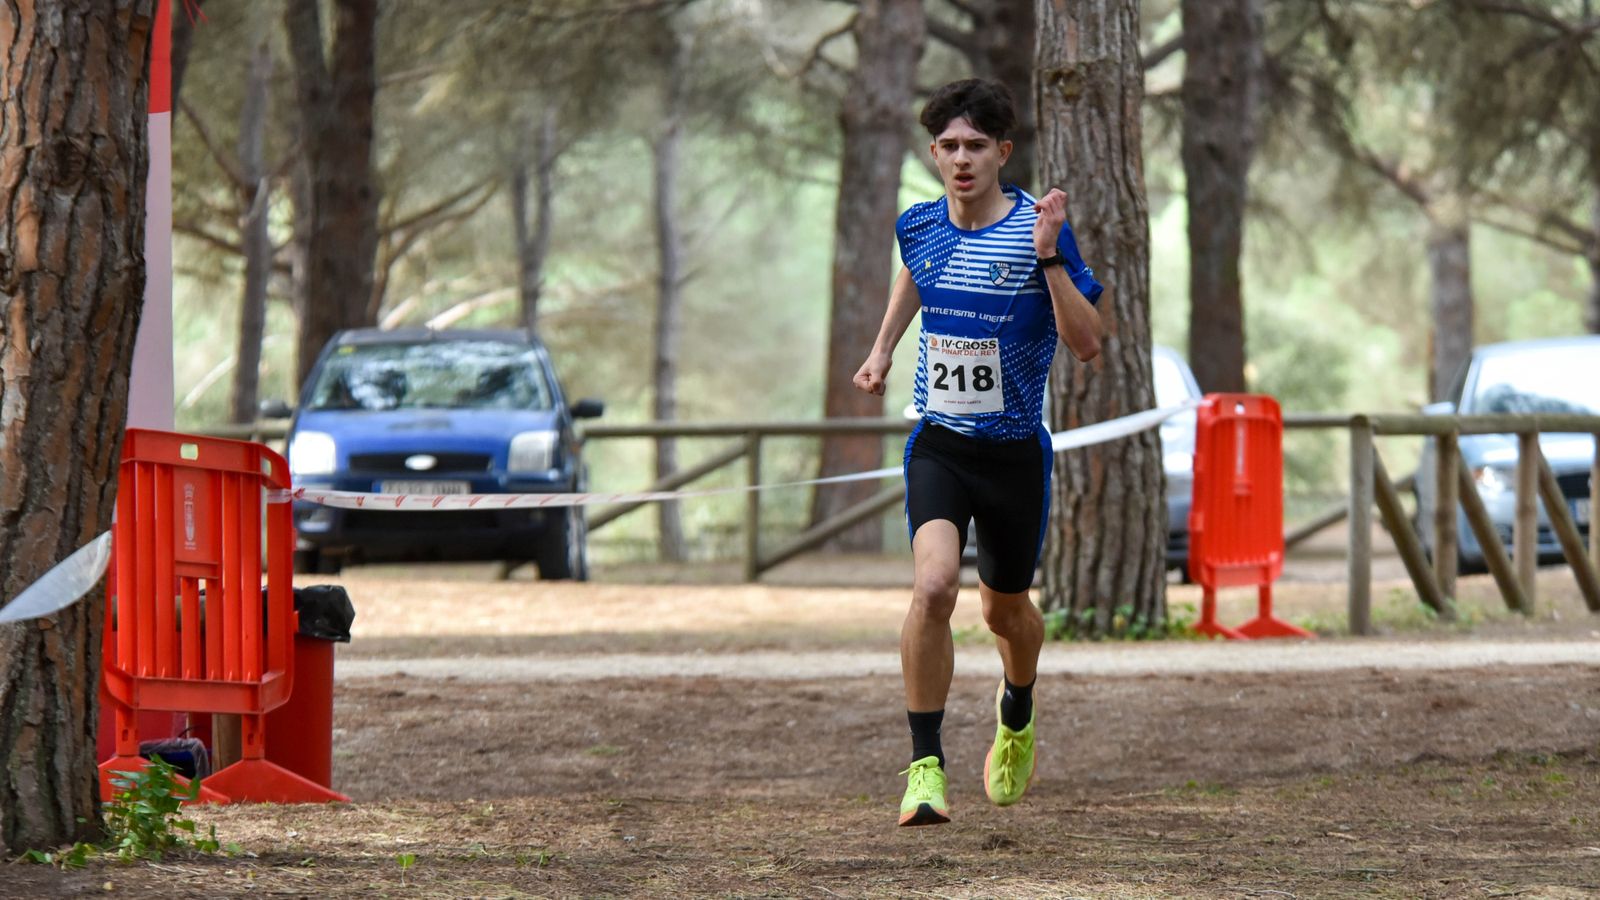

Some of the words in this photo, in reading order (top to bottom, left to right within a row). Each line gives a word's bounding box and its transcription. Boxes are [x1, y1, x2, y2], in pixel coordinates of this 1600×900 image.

[930, 306, 976, 318] ATLETISMO
[979, 313, 1014, 322] LINENSE
[933, 362, 995, 392] 218
